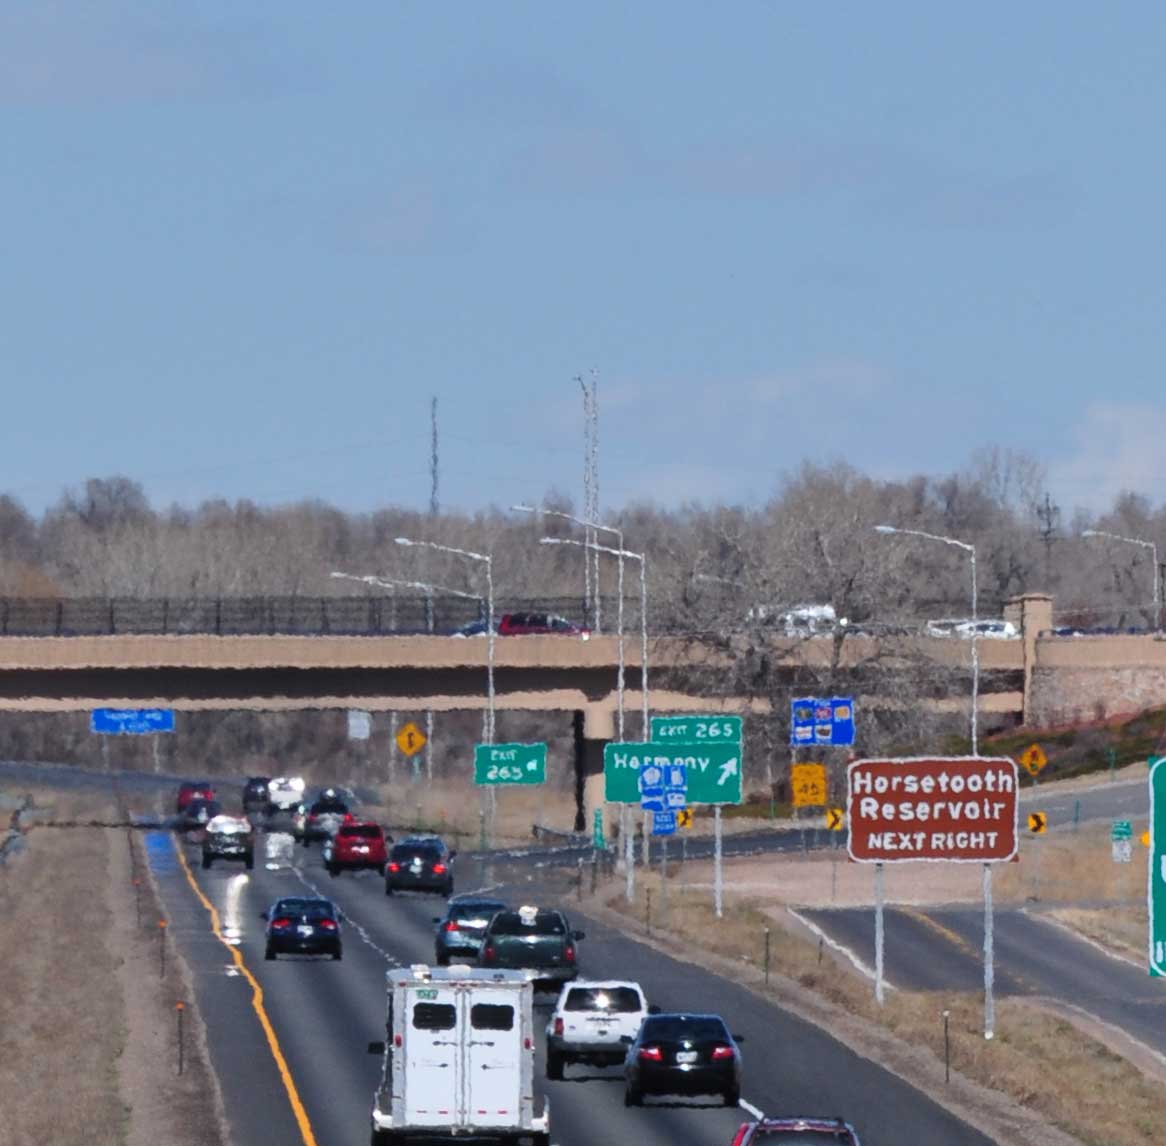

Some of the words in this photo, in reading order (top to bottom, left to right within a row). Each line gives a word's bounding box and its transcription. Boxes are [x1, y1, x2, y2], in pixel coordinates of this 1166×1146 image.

[659, 725, 688, 736] EXIT
[696, 722, 733, 738] 265
[613, 752, 710, 772] Harmony
[487, 765, 522, 780] 265
[853, 769, 1013, 794] Horsetooth
[860, 797, 1006, 821] Reservoir
[868, 832, 926, 850] NEXT
[931, 832, 998, 849] RIGHT
